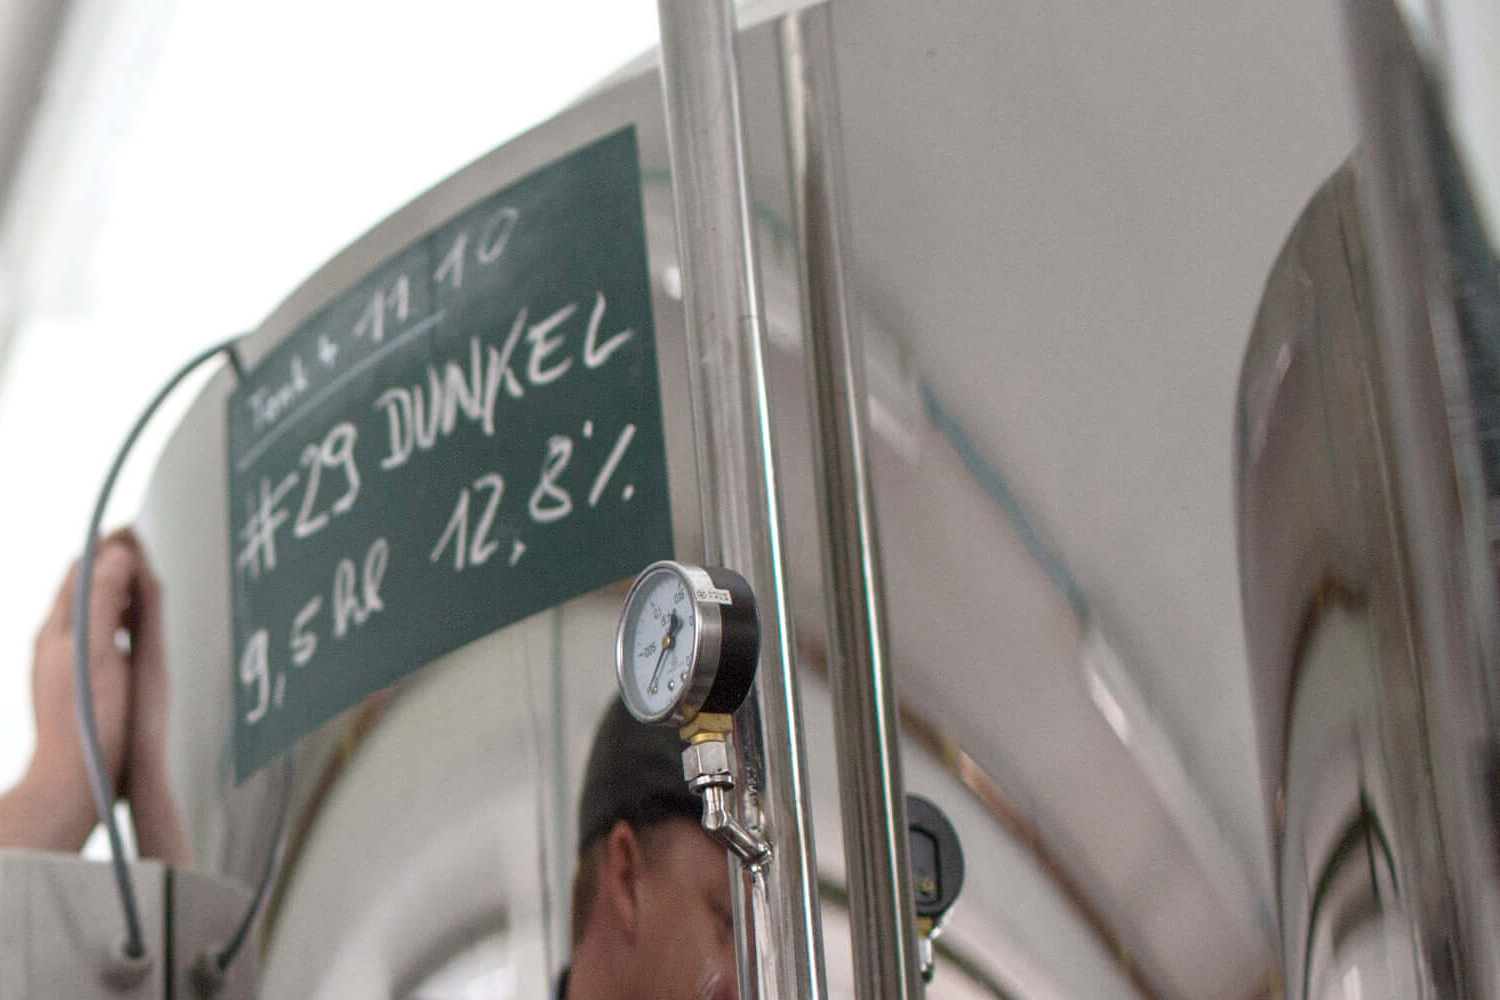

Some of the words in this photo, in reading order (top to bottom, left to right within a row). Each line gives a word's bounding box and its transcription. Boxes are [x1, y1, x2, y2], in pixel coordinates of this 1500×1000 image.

[433, 205, 519, 289] 10
[236, 421, 361, 580] #29
[372, 290, 635, 471] DUNKEL
